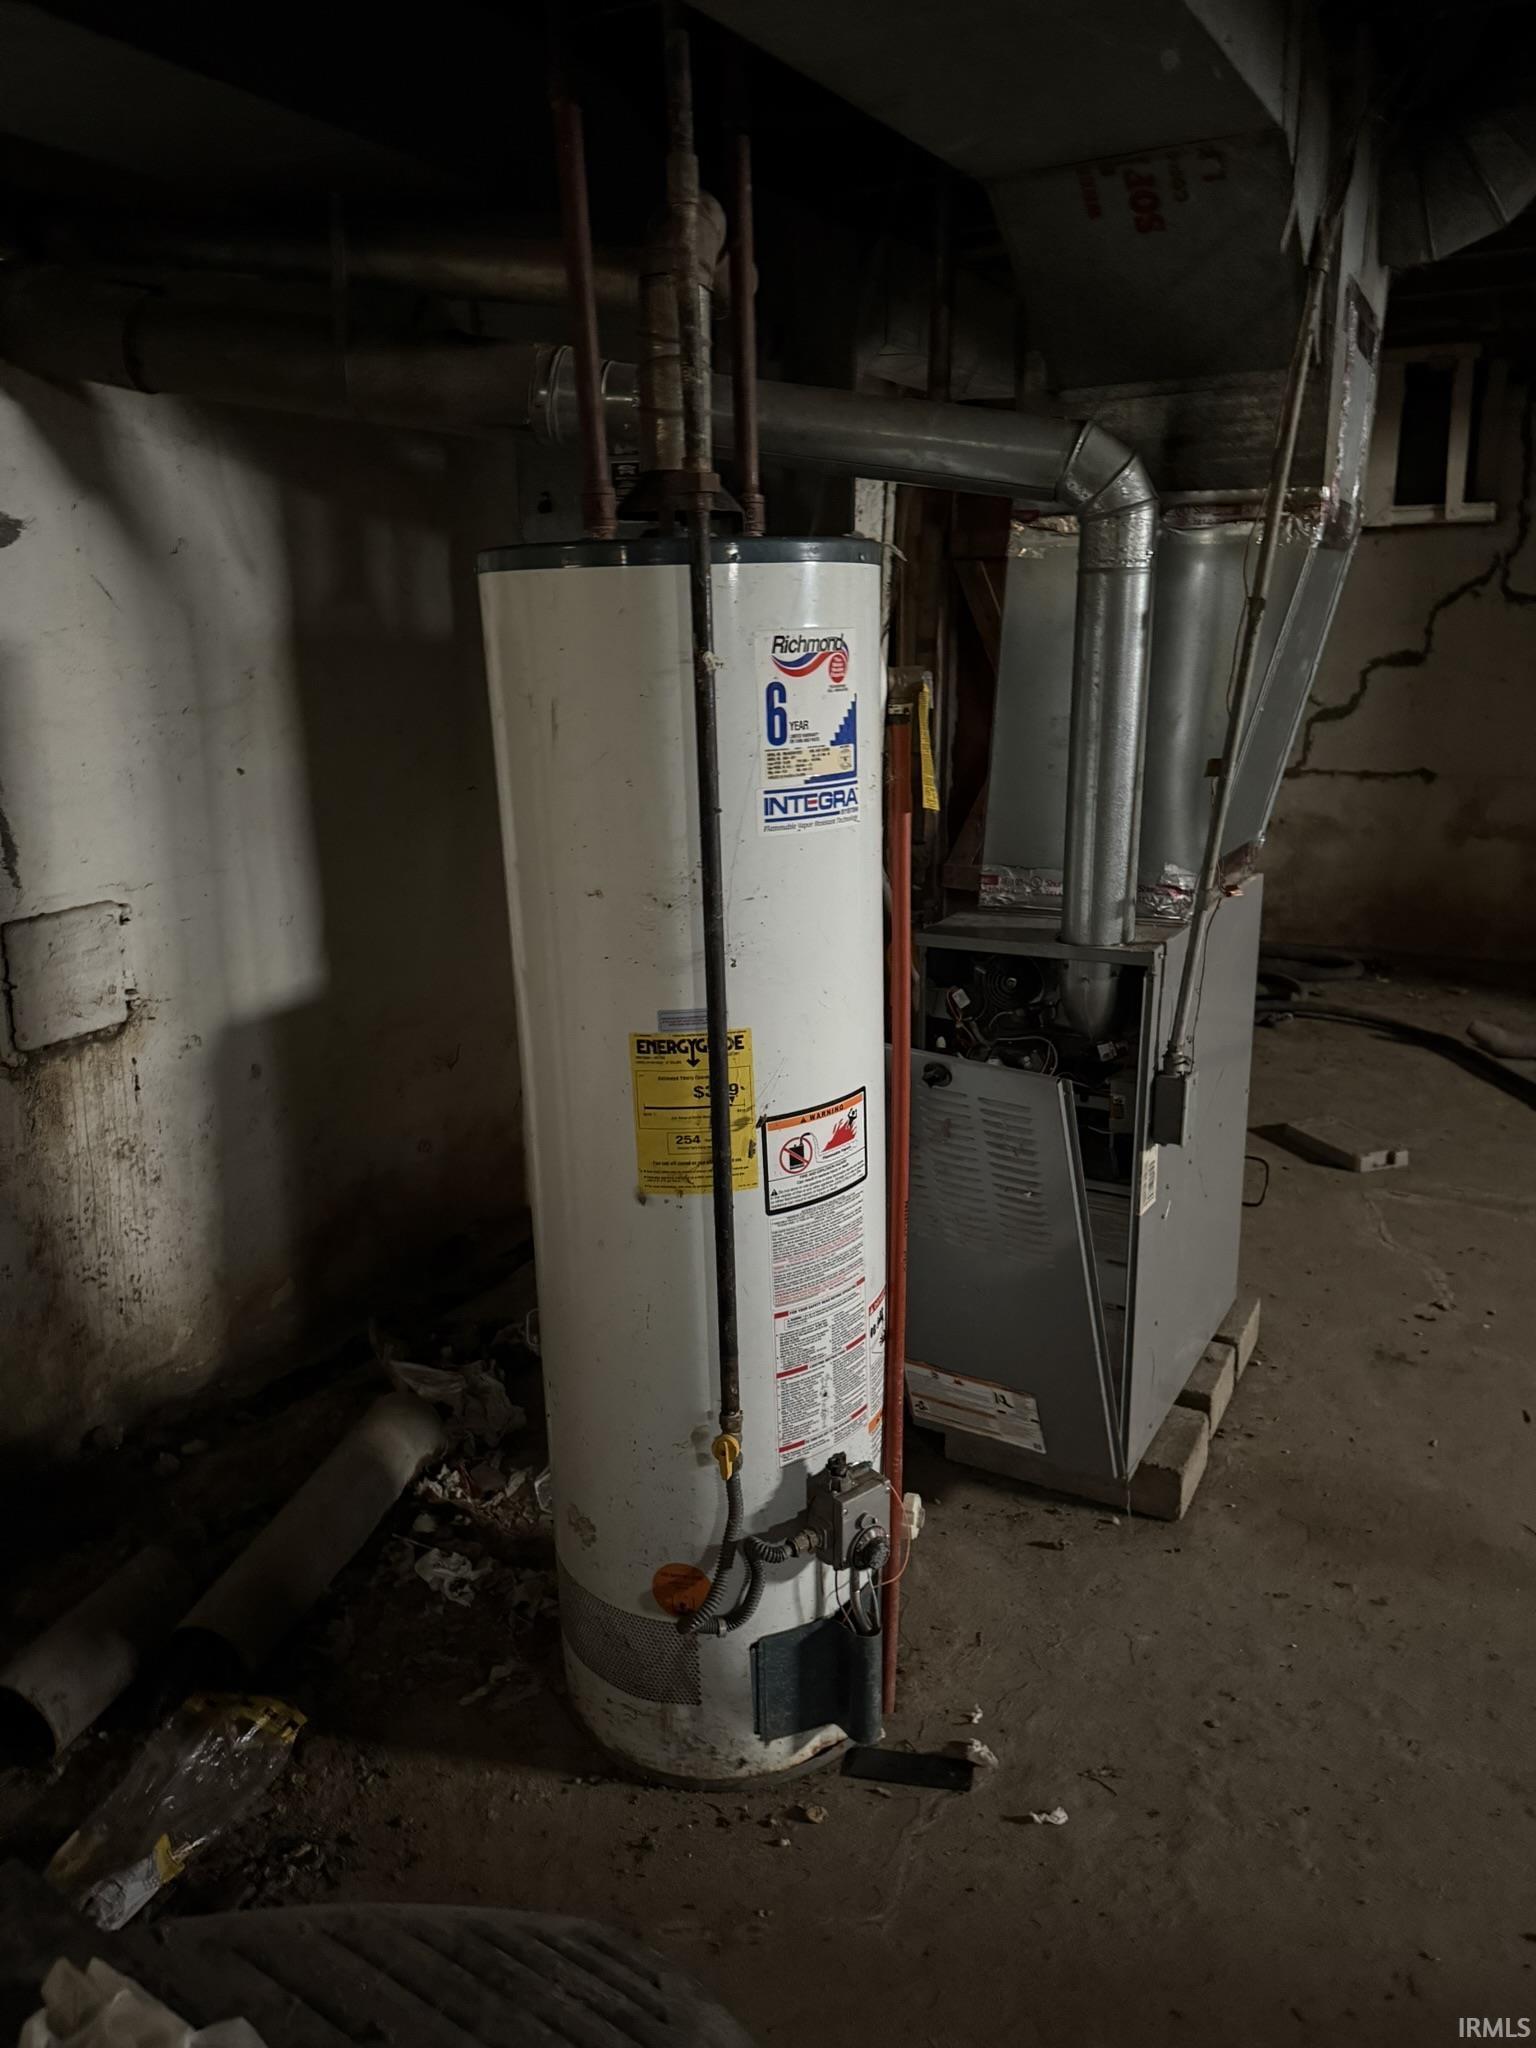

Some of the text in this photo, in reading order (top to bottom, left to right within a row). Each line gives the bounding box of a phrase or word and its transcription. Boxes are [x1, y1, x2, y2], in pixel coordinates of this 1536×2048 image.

[771, 634, 844, 654] Richmond
[766, 681, 787, 746] 6
[789, 720, 810, 731] YEAR
[764, 787, 859, 816] INTEGRA
[693, 1083, 739, 1099] $39
[809, 1104, 844, 1121] WARNING
[676, 1135, 702, 1145] 254
